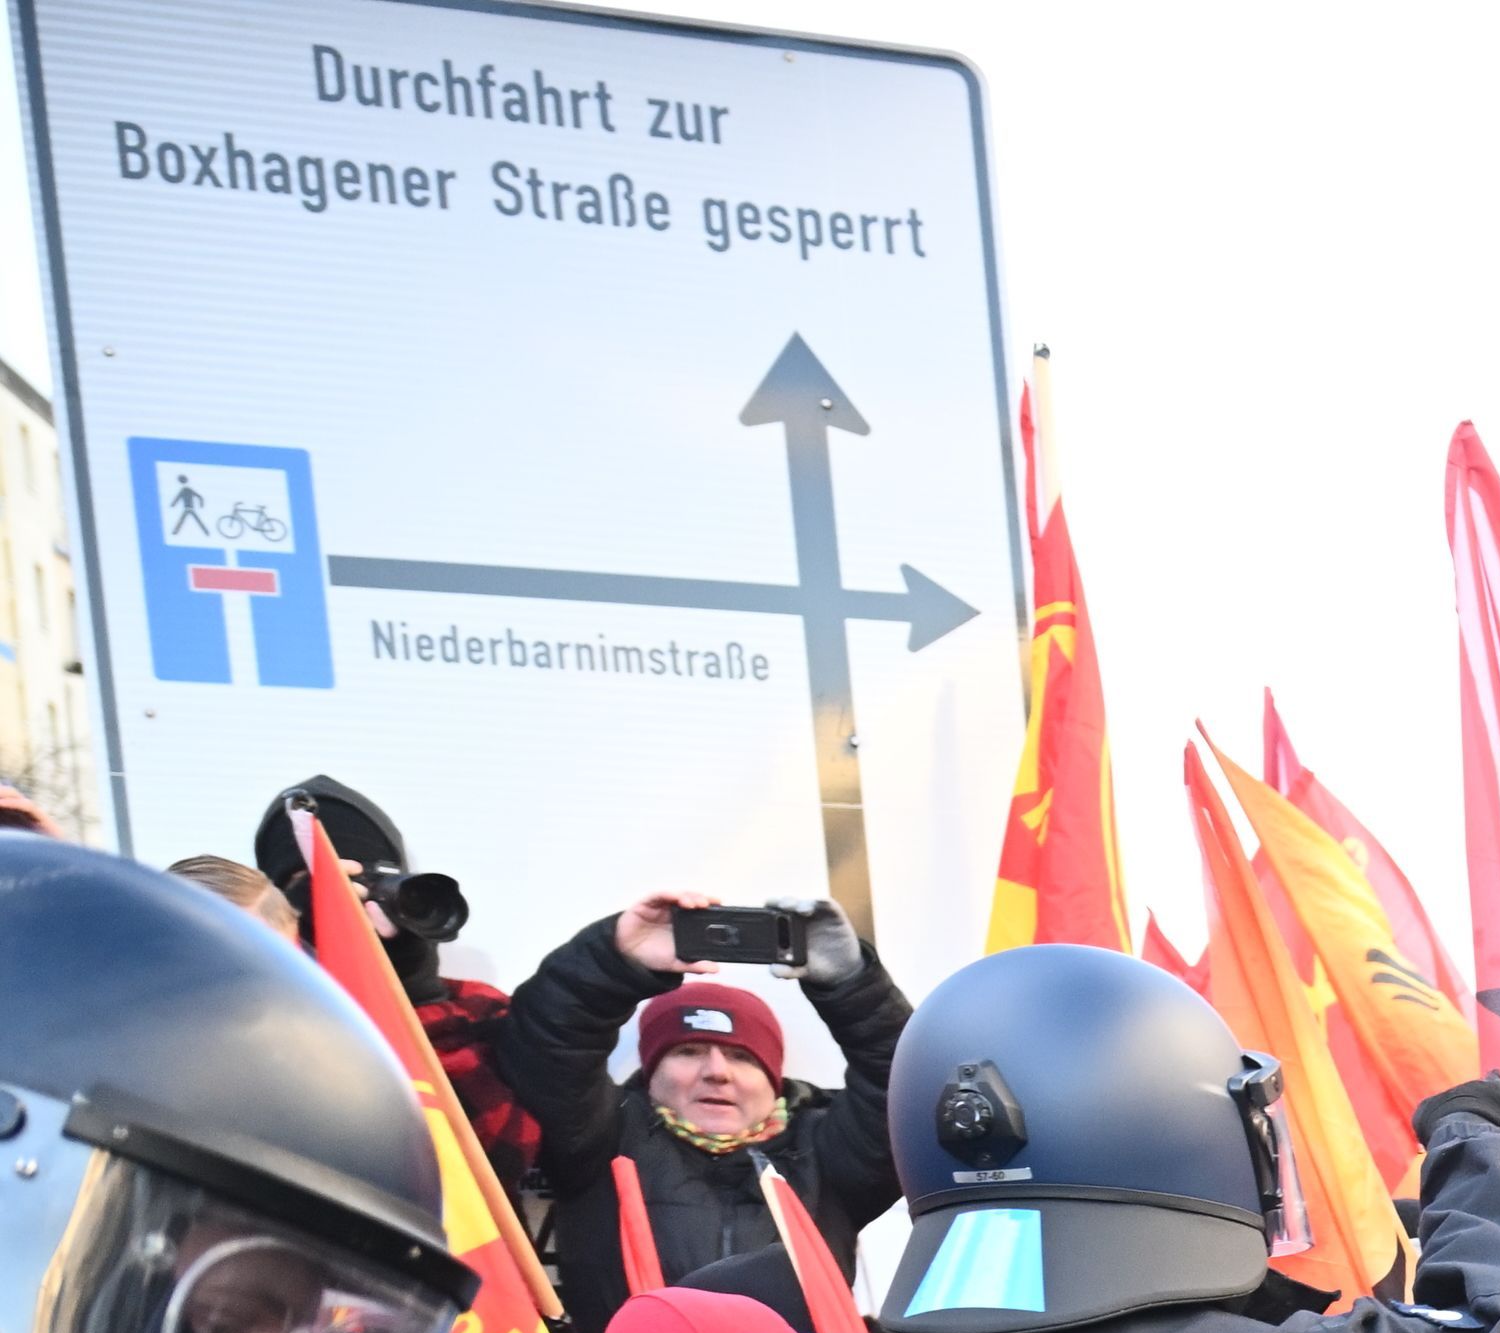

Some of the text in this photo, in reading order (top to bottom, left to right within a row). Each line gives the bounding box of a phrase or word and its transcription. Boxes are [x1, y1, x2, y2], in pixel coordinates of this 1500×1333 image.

[312, 44, 730, 144] Durchfahrt zur
[114, 120, 927, 260] Boxhagener Straße gesperrt
[370, 620, 770, 681] Niederbarnimstraße
